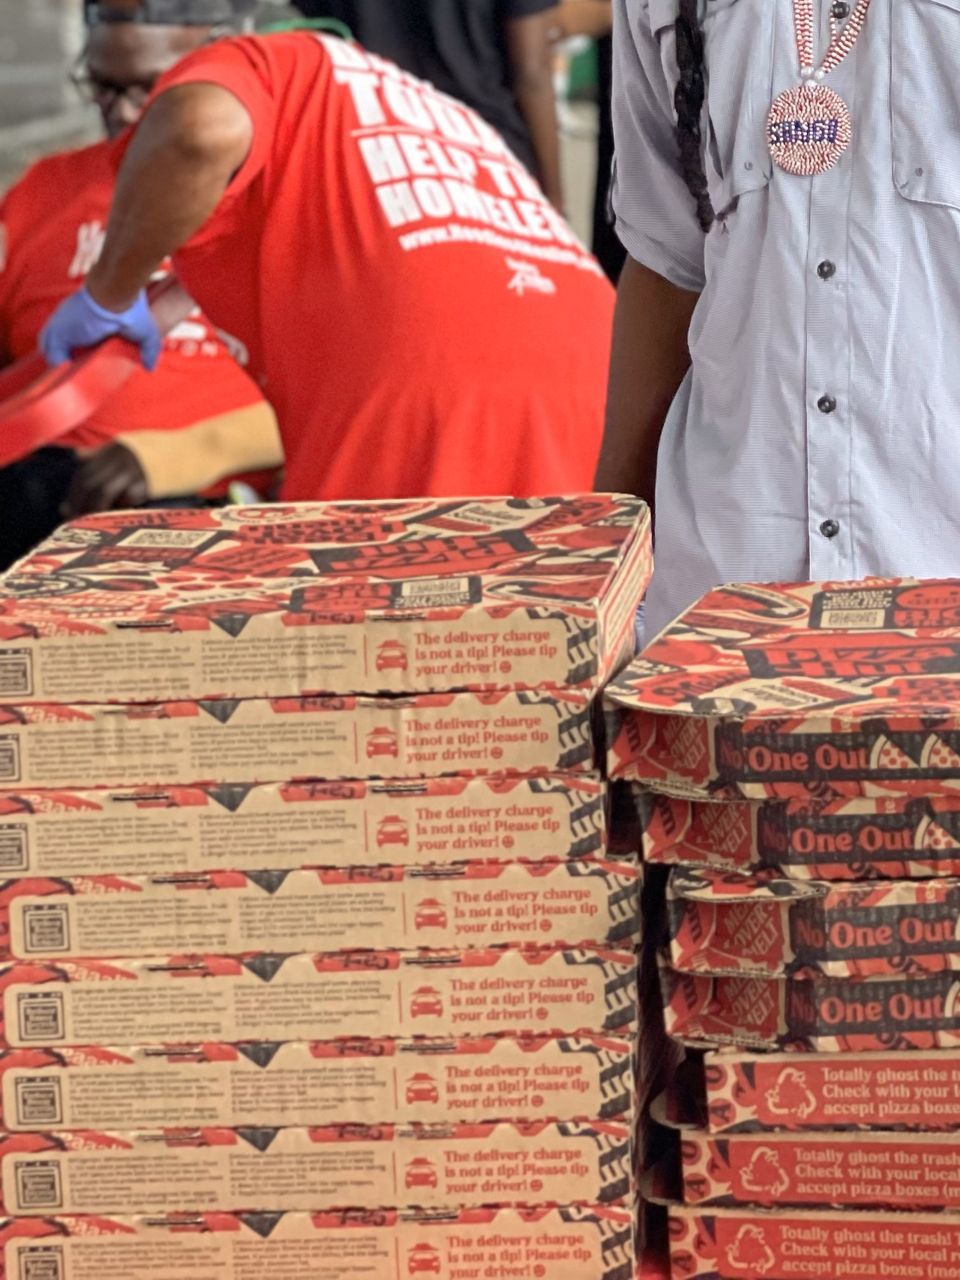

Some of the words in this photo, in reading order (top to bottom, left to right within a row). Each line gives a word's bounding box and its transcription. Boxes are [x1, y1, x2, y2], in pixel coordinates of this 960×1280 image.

[357, 131, 479, 184] HELP
[375, 178, 590, 252] HOMELE
[414, 632, 440, 645] The
[444, 631, 499, 645] delivery
[503, 629, 550, 644] charge
[415, 648, 427, 660] is
[430, 648, 452, 660] not
[467, 646, 488, 661] tip!
[492, 645, 536, 658] Please
[540, 644, 557, 659] tip
[415, 664, 447, 677] your
[451, 660, 497, 674] driver!
[405, 719, 431, 732] The
[435, 717, 490, 731] delivery
[494, 715, 541, 730] charge
[406, 735, 418, 747] is
[421, 735, 443, 747] not
[458, 732, 479, 747] tip!
[483, 731, 527, 744] Please
[531, 730, 548, 745] tip
[406, 751, 438, 764] your
[442, 746, 488, 760] driver!
[748, 746, 808, 771] One
[815, 743, 869, 770] Out
[415, 807, 441, 820] The
[446, 806, 501, 820] delivery
[506, 804, 553, 819] charge
[416, 823, 428, 835] is
[432, 823, 454, 835] not
[469, 821, 490, 836] tip!
[494, 820, 538, 833] Please
[543, 818, 560, 833] tip
[416, 839, 448, 852] your
[453, 835, 499, 849] driver!
[791, 827, 852, 853] One
[858, 825, 914, 851] Out
[453, 890, 479, 903] The
[484, 889, 539, 903] delivery
[543, 887, 590, 902] charge
[454, 906, 466, 918] is
[470, 906, 492, 918] not
[507, 904, 528, 919] tip!
[532, 903, 576, 916] Please
[581, 902, 598, 917] tip
[455, 922, 487, 935] your
[491, 918, 537, 932] driver!
[830, 920, 892, 948] One
[900, 917, 955, 946] Out
[820, 996, 882, 1025] One
[889, 993, 944, 1022] Out
[822, 1067, 872, 1083] Totally
[876, 1068, 919, 1083] ghost
[923, 1068, 947, 1081] the
[822, 1084, 871, 1097] Check
[875, 1084, 910, 1097] with
[915, 1086, 949, 1099] your
[823, 1102, 875, 1117] accept
[879, 1101, 920, 1117] pizza
[794, 1147, 844, 1163] Totally
[848, 1150, 890, 1165] ghost
[894, 1150, 918, 1164] the
[795, 1164, 843, 1177] Check
[848, 1167, 881, 1179] with
[886, 1168, 921, 1182] your
[797, 1182, 847, 1197] accept
[851, 1182, 891, 1197] pizza
[895, 1182, 939, 1196] boxes
[779, 1225, 829, 1242] Totally
[833, 1228, 876, 1243] ghost
[880, 1230, 903, 1243] the
[907, 1232, 951, 1246] trash!
[780, 1242, 828, 1256] Check
[833, 1244, 867, 1257] with
[871, 1247, 906, 1260] your
[910, 1247, 947, 1261] local
[782, 1260, 831, 1274] accept
[835, 1260, 876, 1275] pizza
[880, 1262, 923, 1276] boxes
